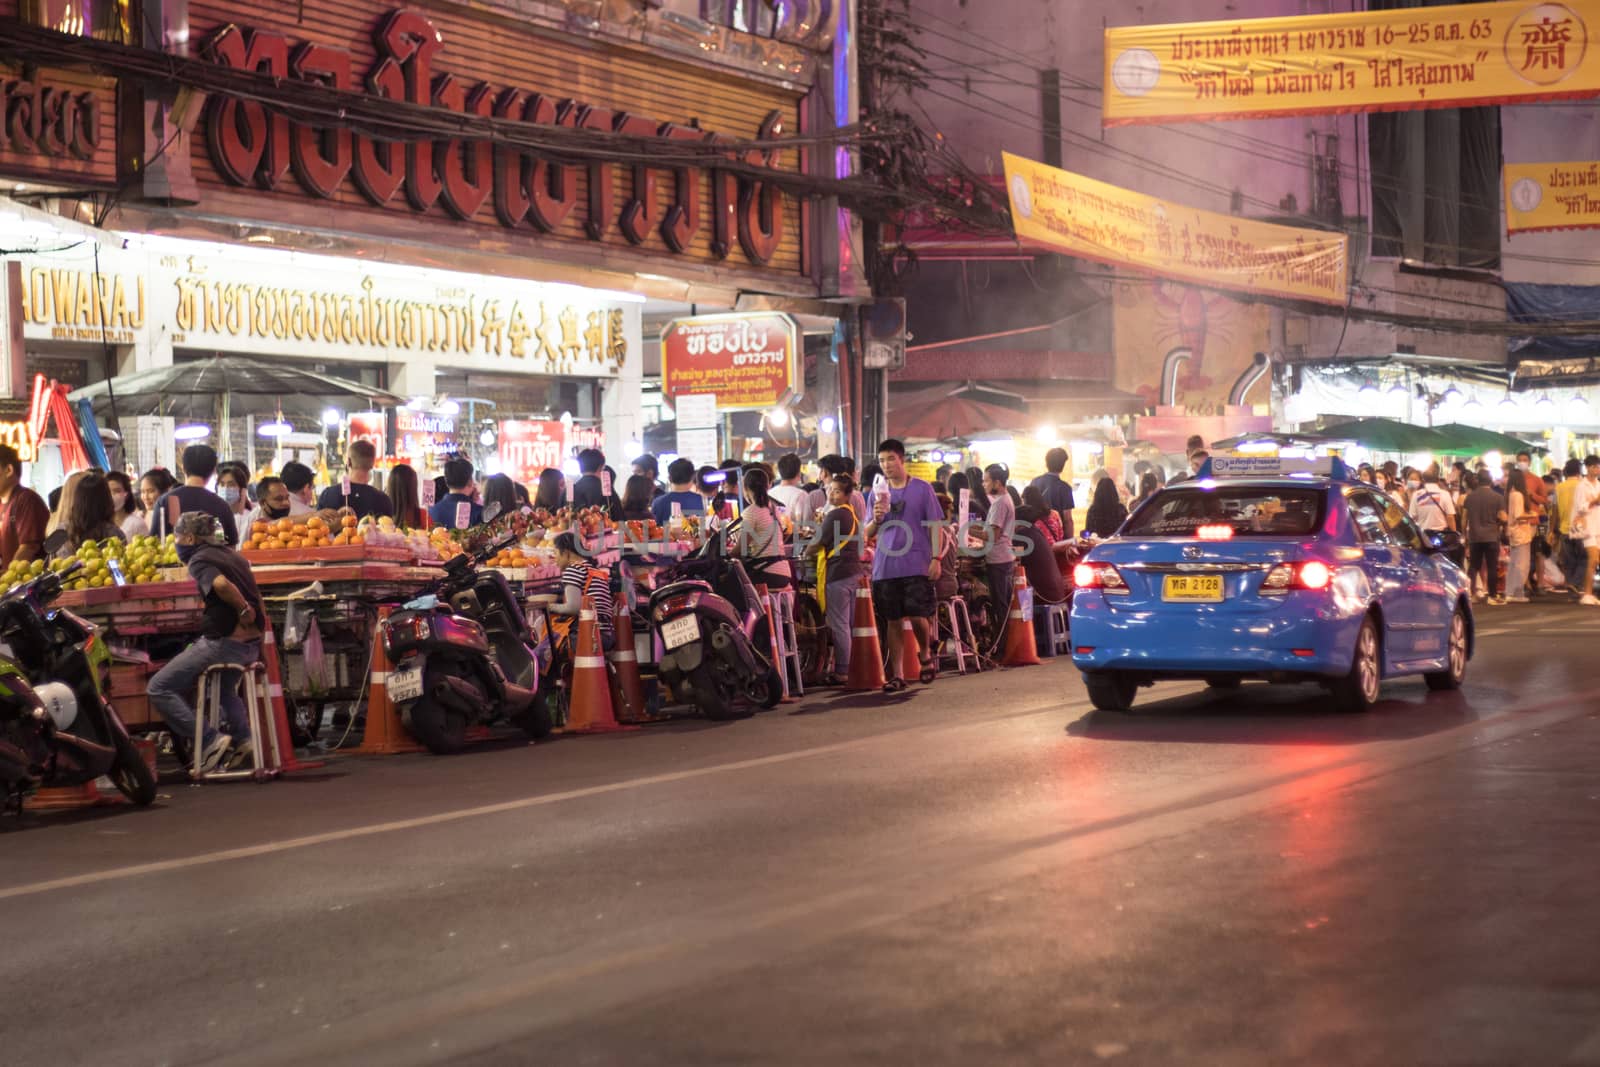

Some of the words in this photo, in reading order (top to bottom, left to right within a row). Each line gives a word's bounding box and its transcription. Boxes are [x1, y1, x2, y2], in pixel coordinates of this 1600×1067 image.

[1299, 26, 1366, 51] เยาวราช
[1470, 18, 1493, 39] 63
[1549, 163, 1600, 188] ประเพณี
[685, 319, 769, 356] ทองใบ
[732, 348, 786, 366] เยาวราช
[1192, 578, 1219, 591] 2128
